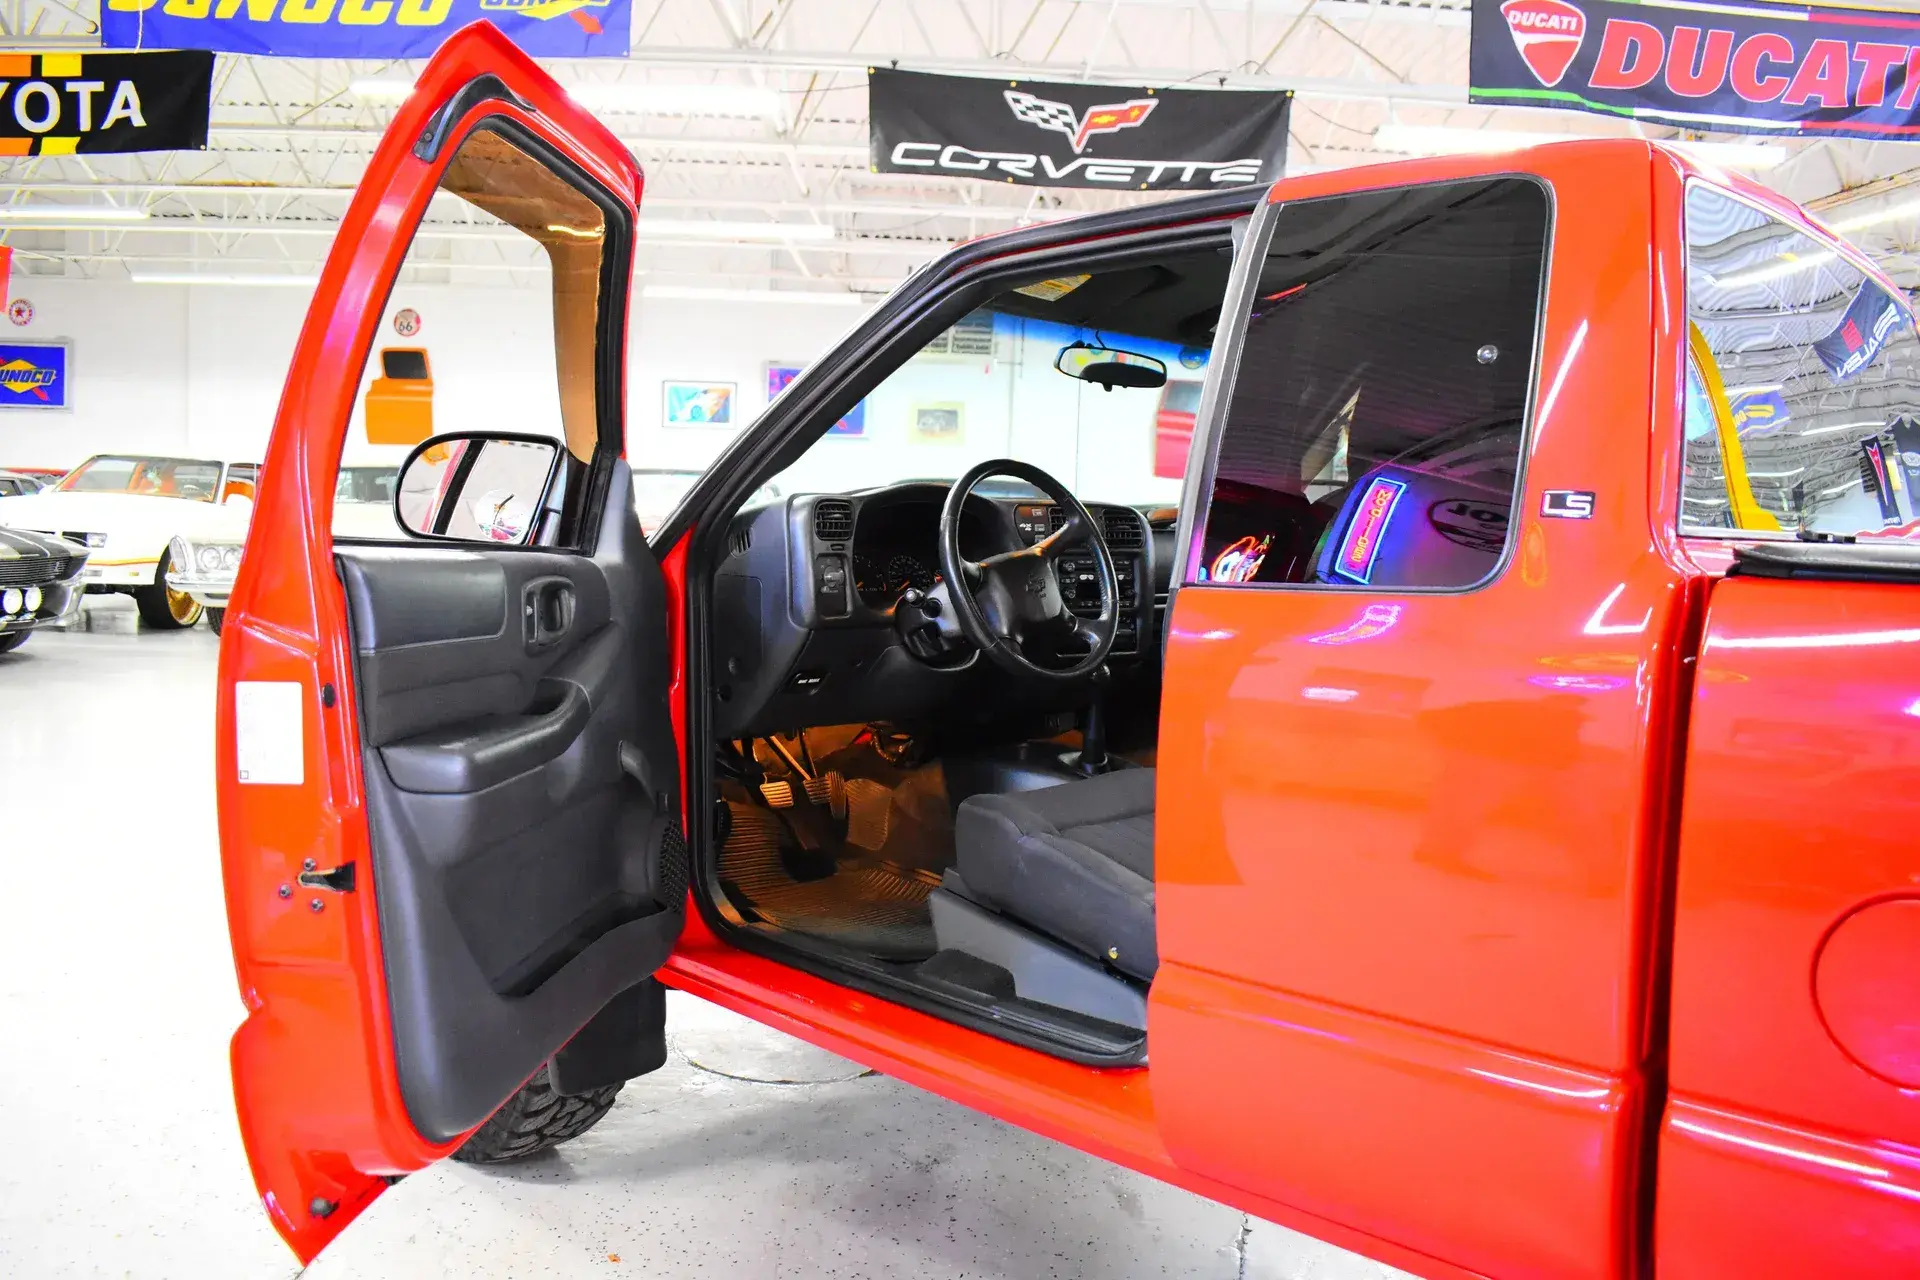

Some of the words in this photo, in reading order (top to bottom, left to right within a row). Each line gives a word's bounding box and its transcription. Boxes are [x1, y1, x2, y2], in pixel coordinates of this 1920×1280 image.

[1508, 10, 1578, 31] DUCATI
[1588, 19, 1920, 109] DUCATI
[0, 80, 147, 133] OTA
[890, 142, 1263, 183] CORVETTE
[398, 321, 413, 332] 66
[1543, 493, 1593, 517] LS
